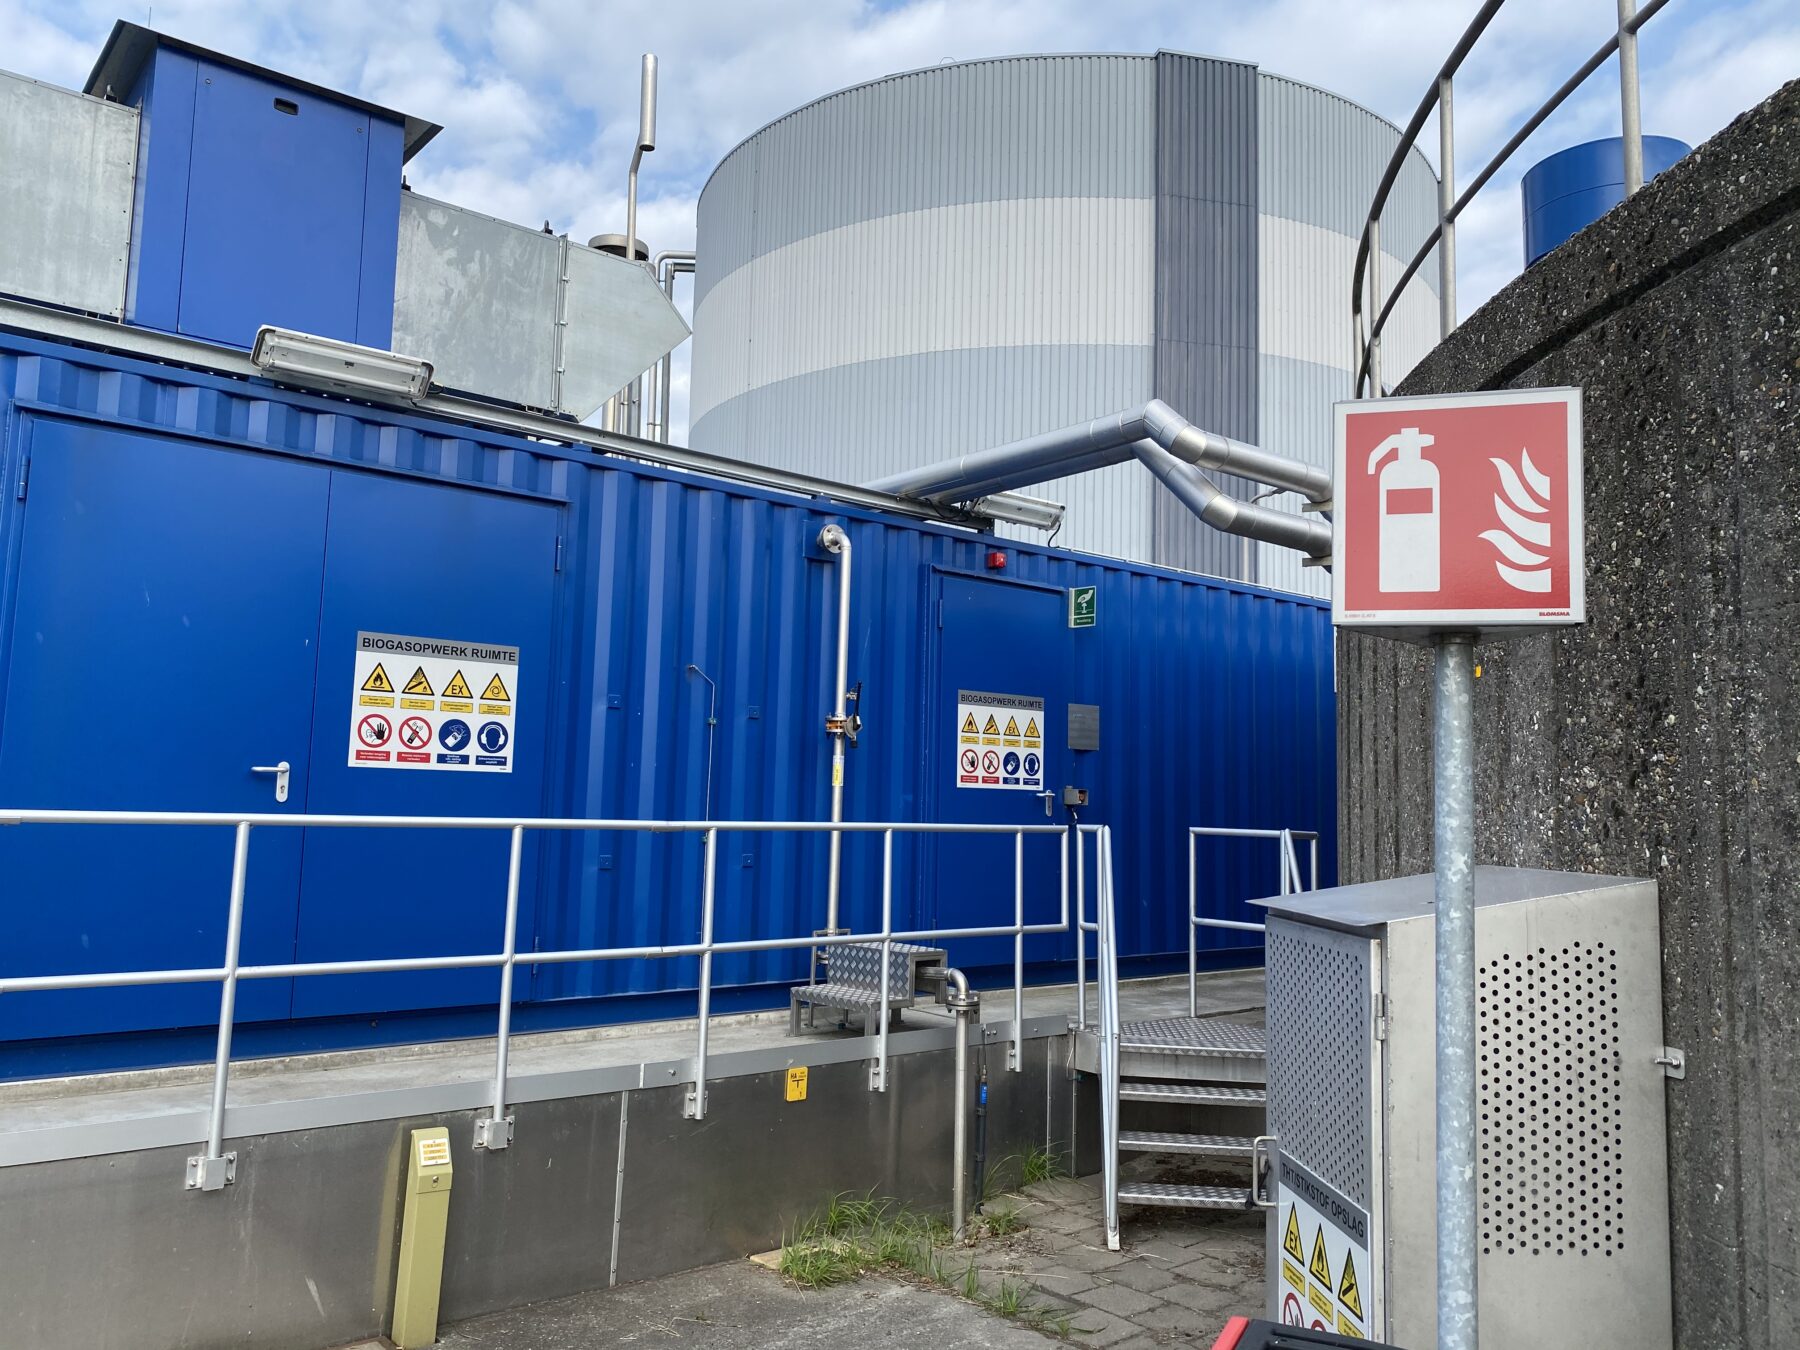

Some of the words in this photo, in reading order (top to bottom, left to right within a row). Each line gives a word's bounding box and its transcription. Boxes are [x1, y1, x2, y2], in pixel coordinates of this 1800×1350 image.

[362, 637, 468, 657] BIOGASOPWERK
[471, 648, 516, 662] RUIMTE
[451, 685, 464, 696] EX
[961, 694, 1017, 707] BIOGASOPWERK
[1018, 700, 1043, 709] RUIMTE
[1008, 726, 1016, 735] EX
[1331, 1200, 1364, 1238] OPSLAG
[1289, 1230, 1299, 1256] EX
